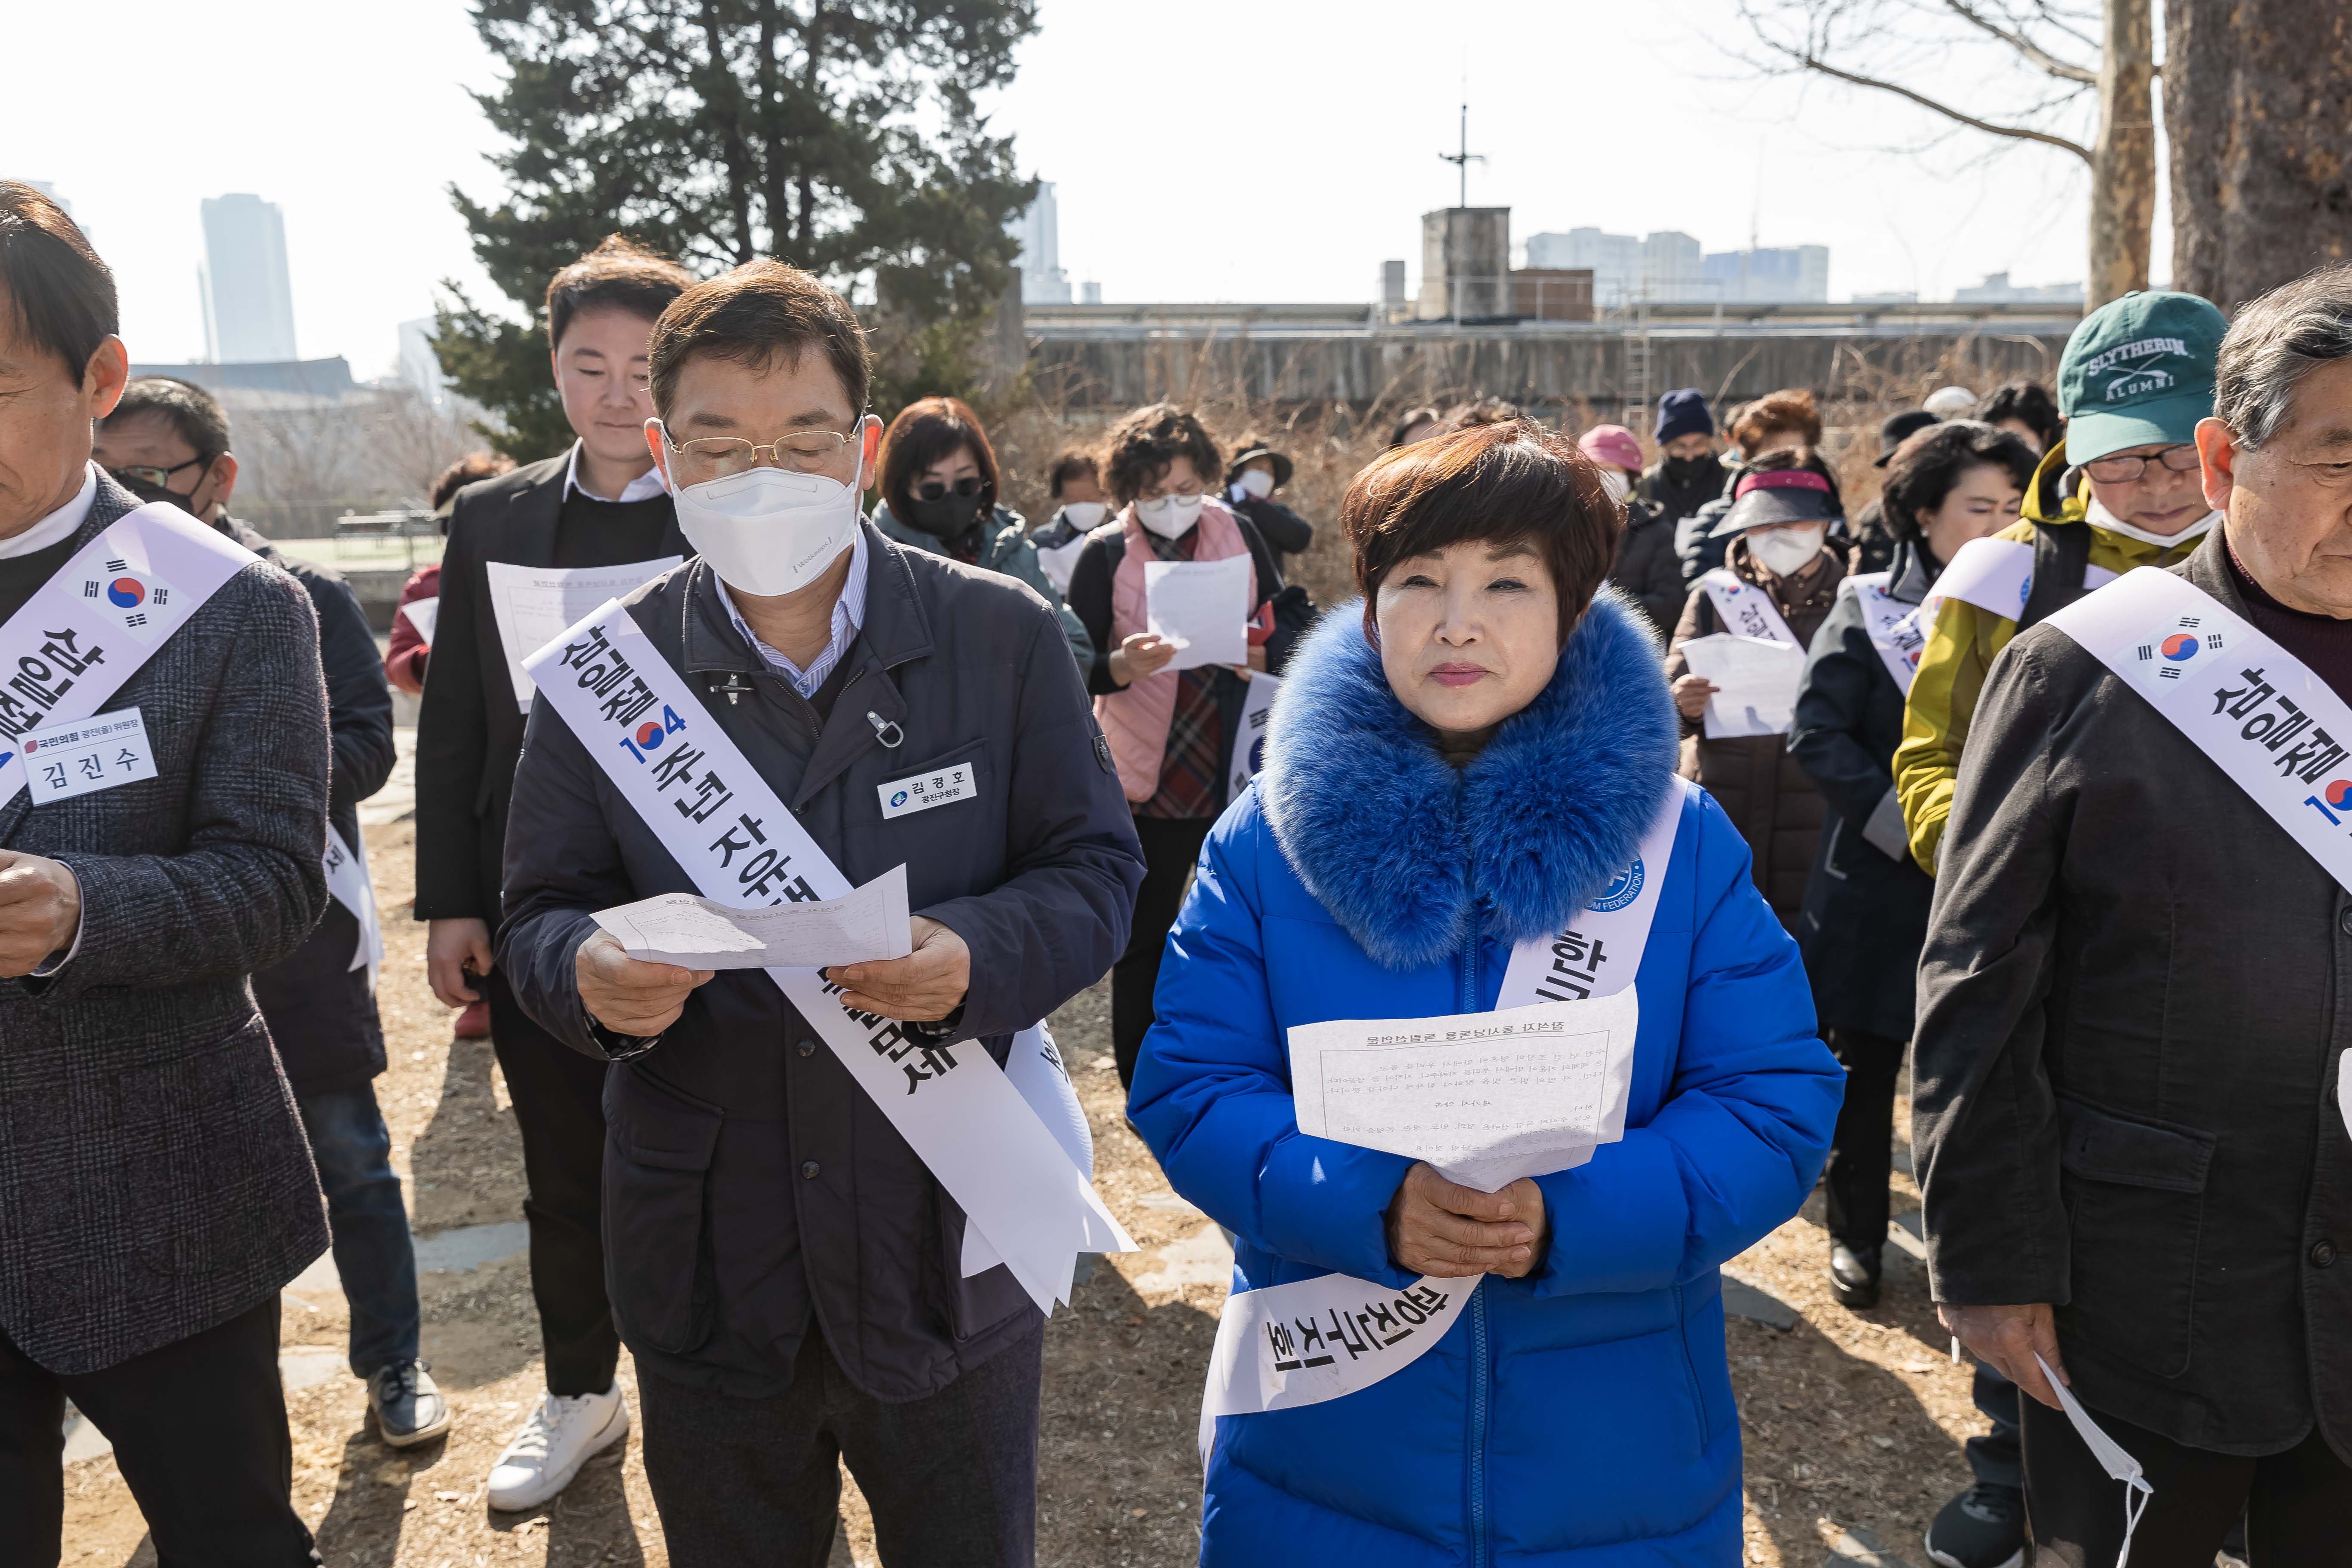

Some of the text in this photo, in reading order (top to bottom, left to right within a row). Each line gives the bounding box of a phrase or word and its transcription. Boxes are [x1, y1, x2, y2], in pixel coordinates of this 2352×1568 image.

[2089, 337, 2189, 377] SLYTHERIN
[2106, 375, 2175, 401] ALUMNI
[558, 625, 660, 728] 삼일절
[38, 719, 138, 748] 국민의힘 광진(을) 위원장
[2211, 668, 2351, 785] 삼일절
[921, 787, 961, 804] 광진구청장
[1266, 1286, 1449, 1372] 광진구지회
